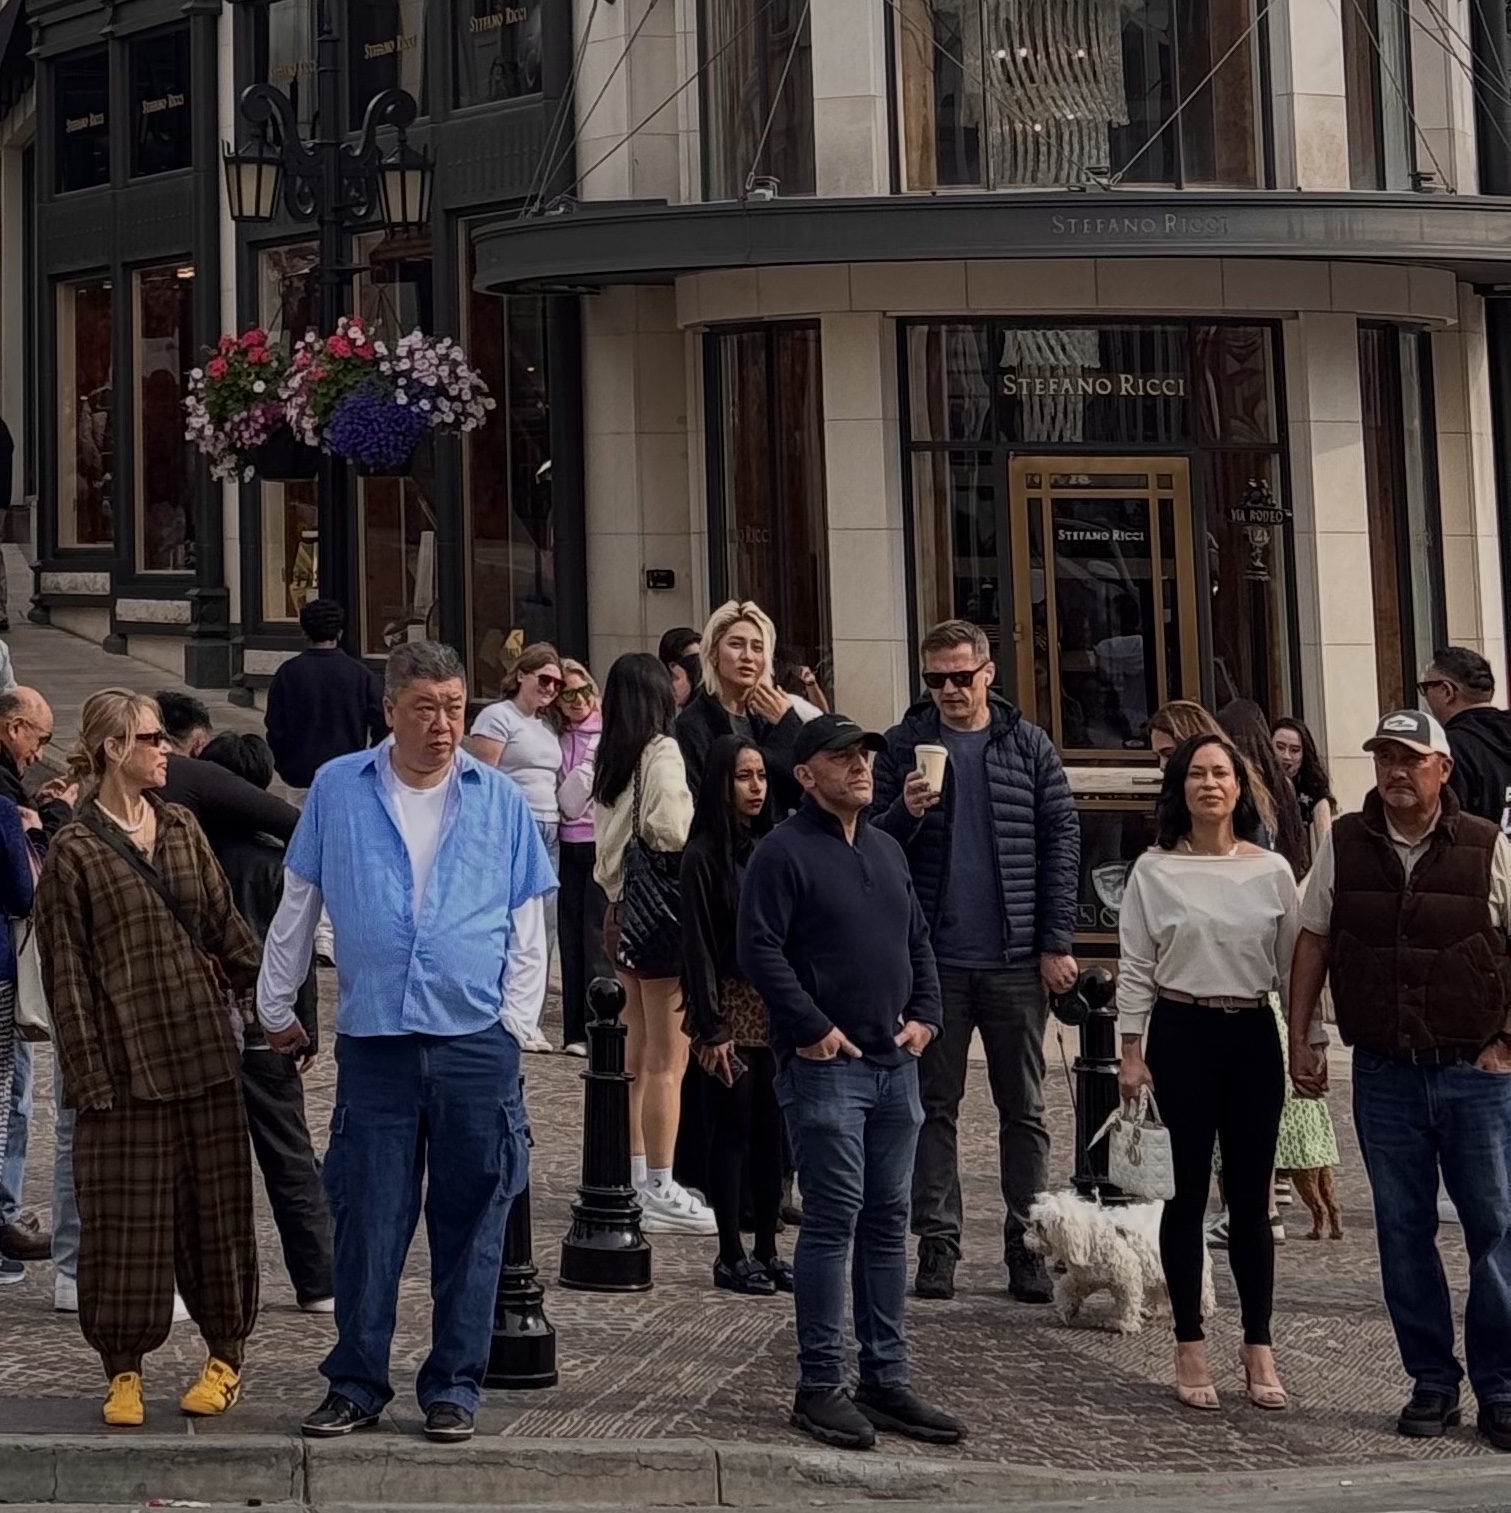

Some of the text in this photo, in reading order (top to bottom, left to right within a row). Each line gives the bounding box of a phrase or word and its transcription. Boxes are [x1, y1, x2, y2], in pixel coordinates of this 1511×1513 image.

[1052, 213, 1229, 234] STEFANO RICCI
[1003, 374, 1185, 396] STEFANO RICCI
[1057, 529, 1144, 541] STEFANO RICCI
